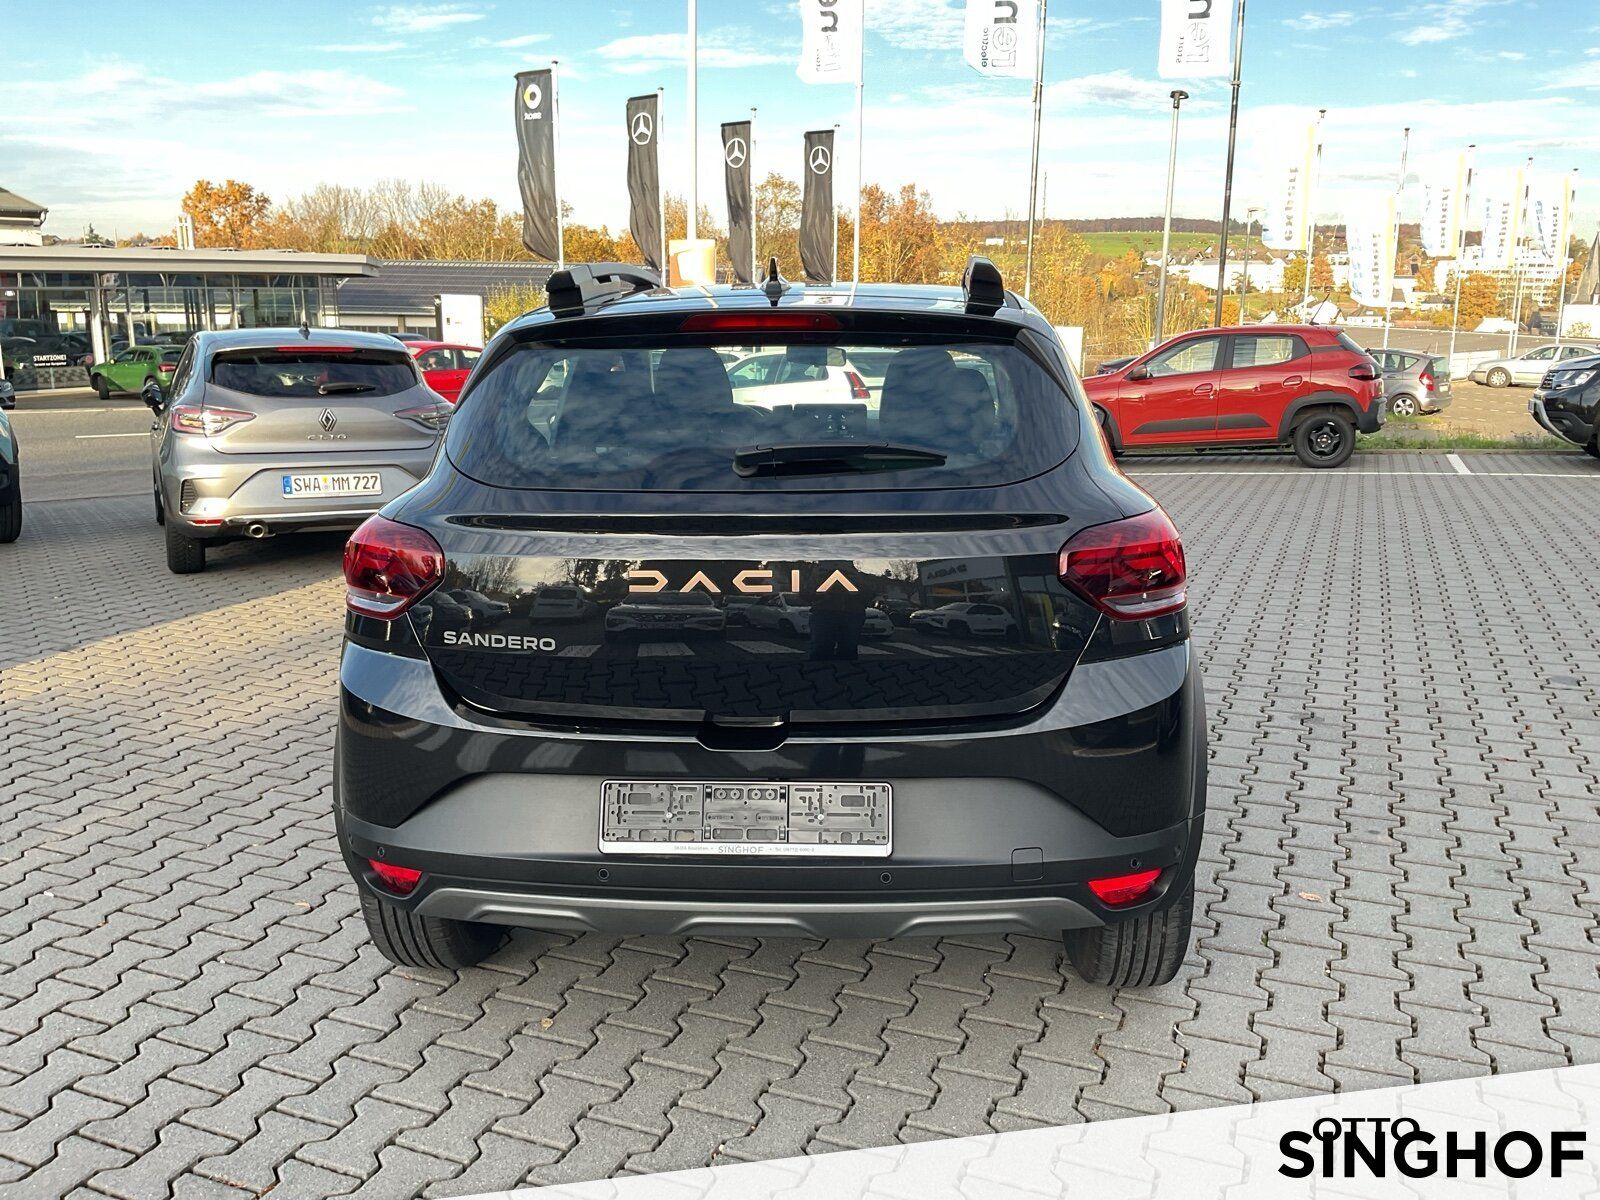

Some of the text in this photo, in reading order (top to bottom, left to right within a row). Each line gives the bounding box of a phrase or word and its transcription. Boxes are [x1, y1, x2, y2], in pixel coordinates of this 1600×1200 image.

[293, 475, 378, 492] SWA MM 727
[628, 570, 858, 592] DACIA
[443, 631, 556, 651] SANDERO
[718, 845, 764, 854] SINGHOF
